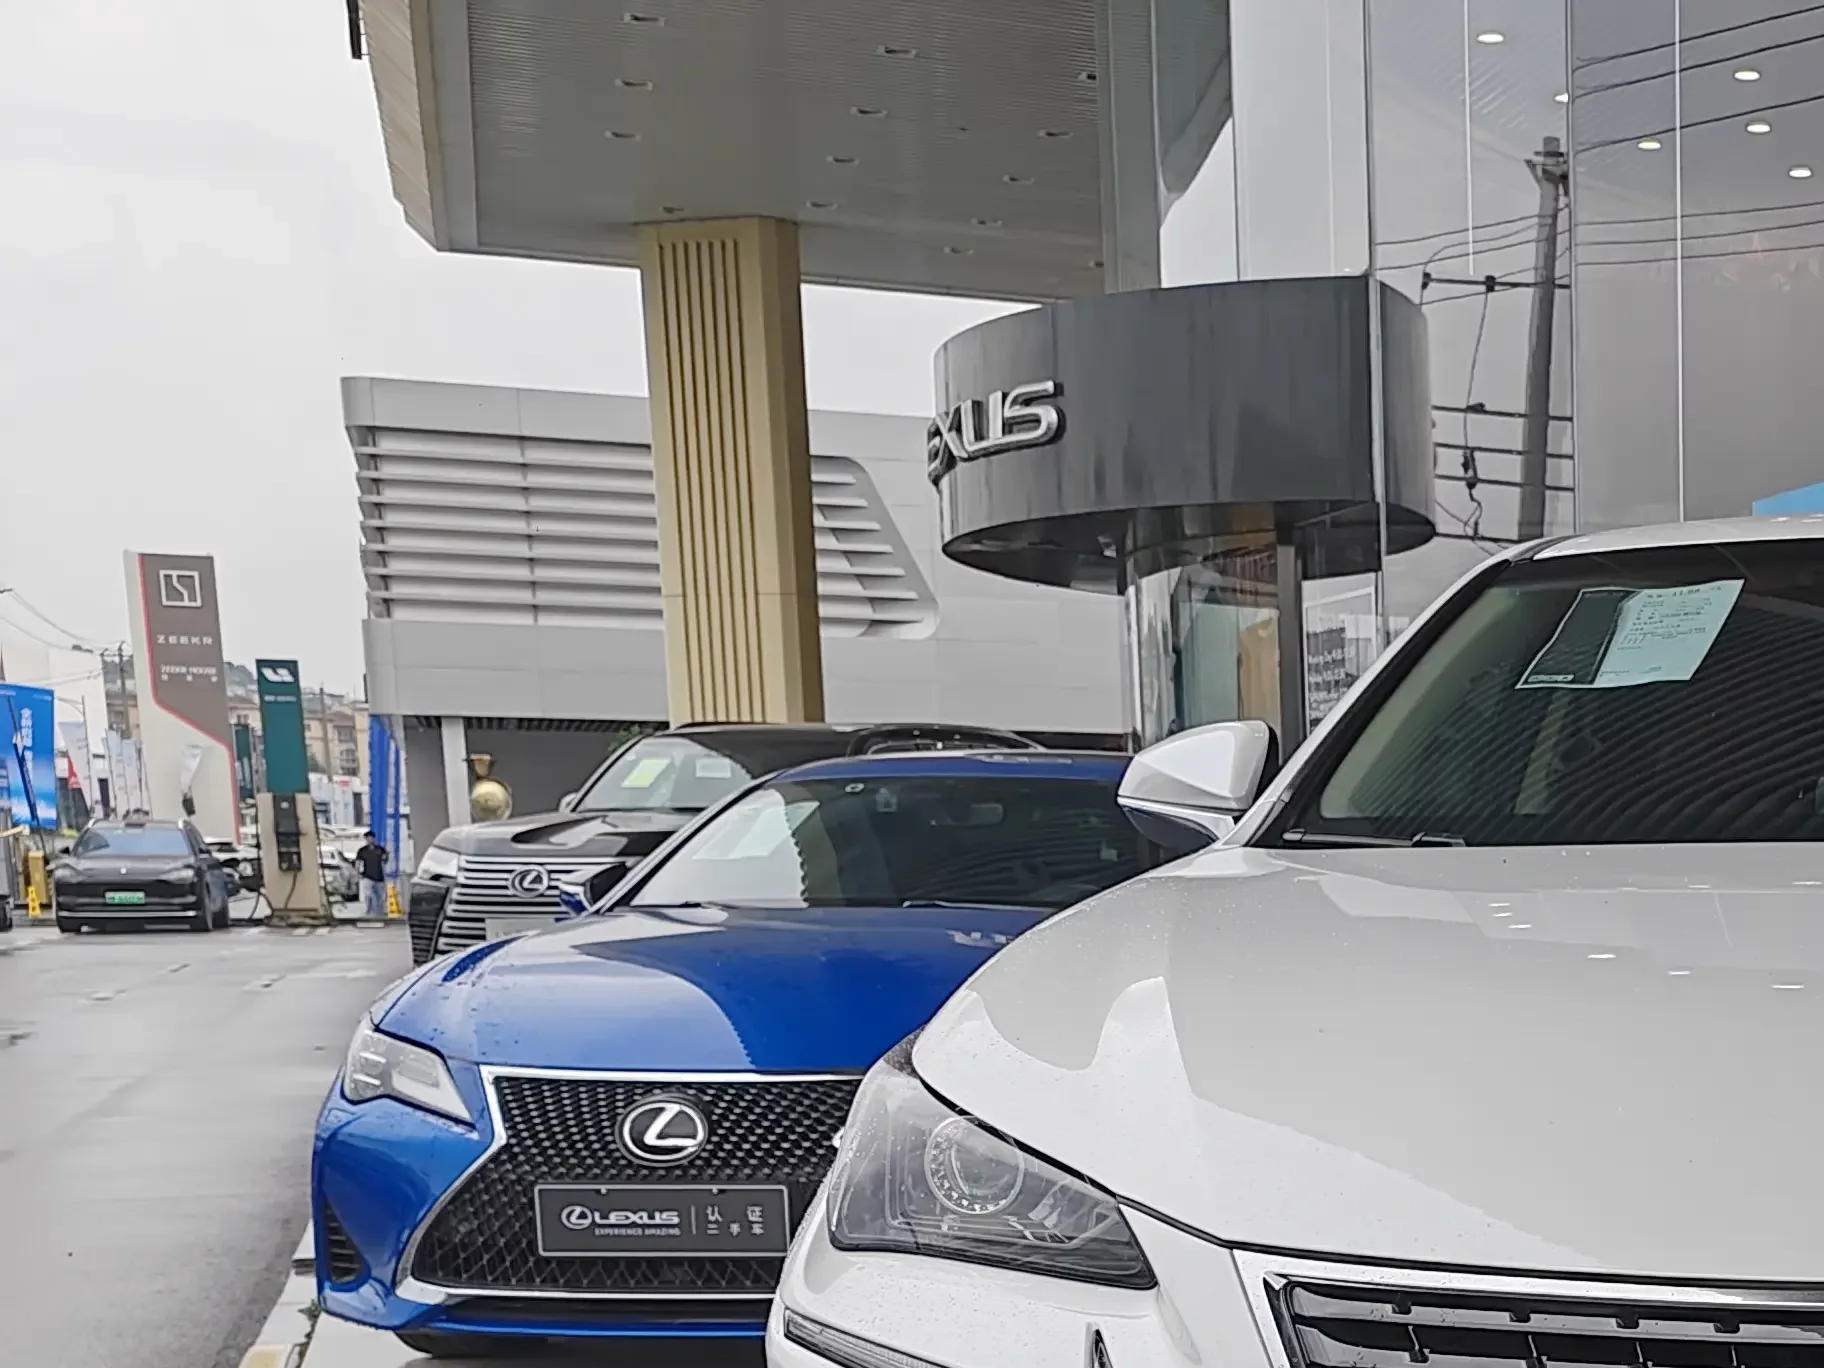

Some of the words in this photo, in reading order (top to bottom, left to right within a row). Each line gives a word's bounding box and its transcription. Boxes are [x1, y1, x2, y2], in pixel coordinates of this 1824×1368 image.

[157, 634, 213, 645] ZEEKR
[593, 1210, 681, 1225] LEXUS
[706, 1205, 764, 1223] 认证
[706, 1222, 765, 1236] 二手车
